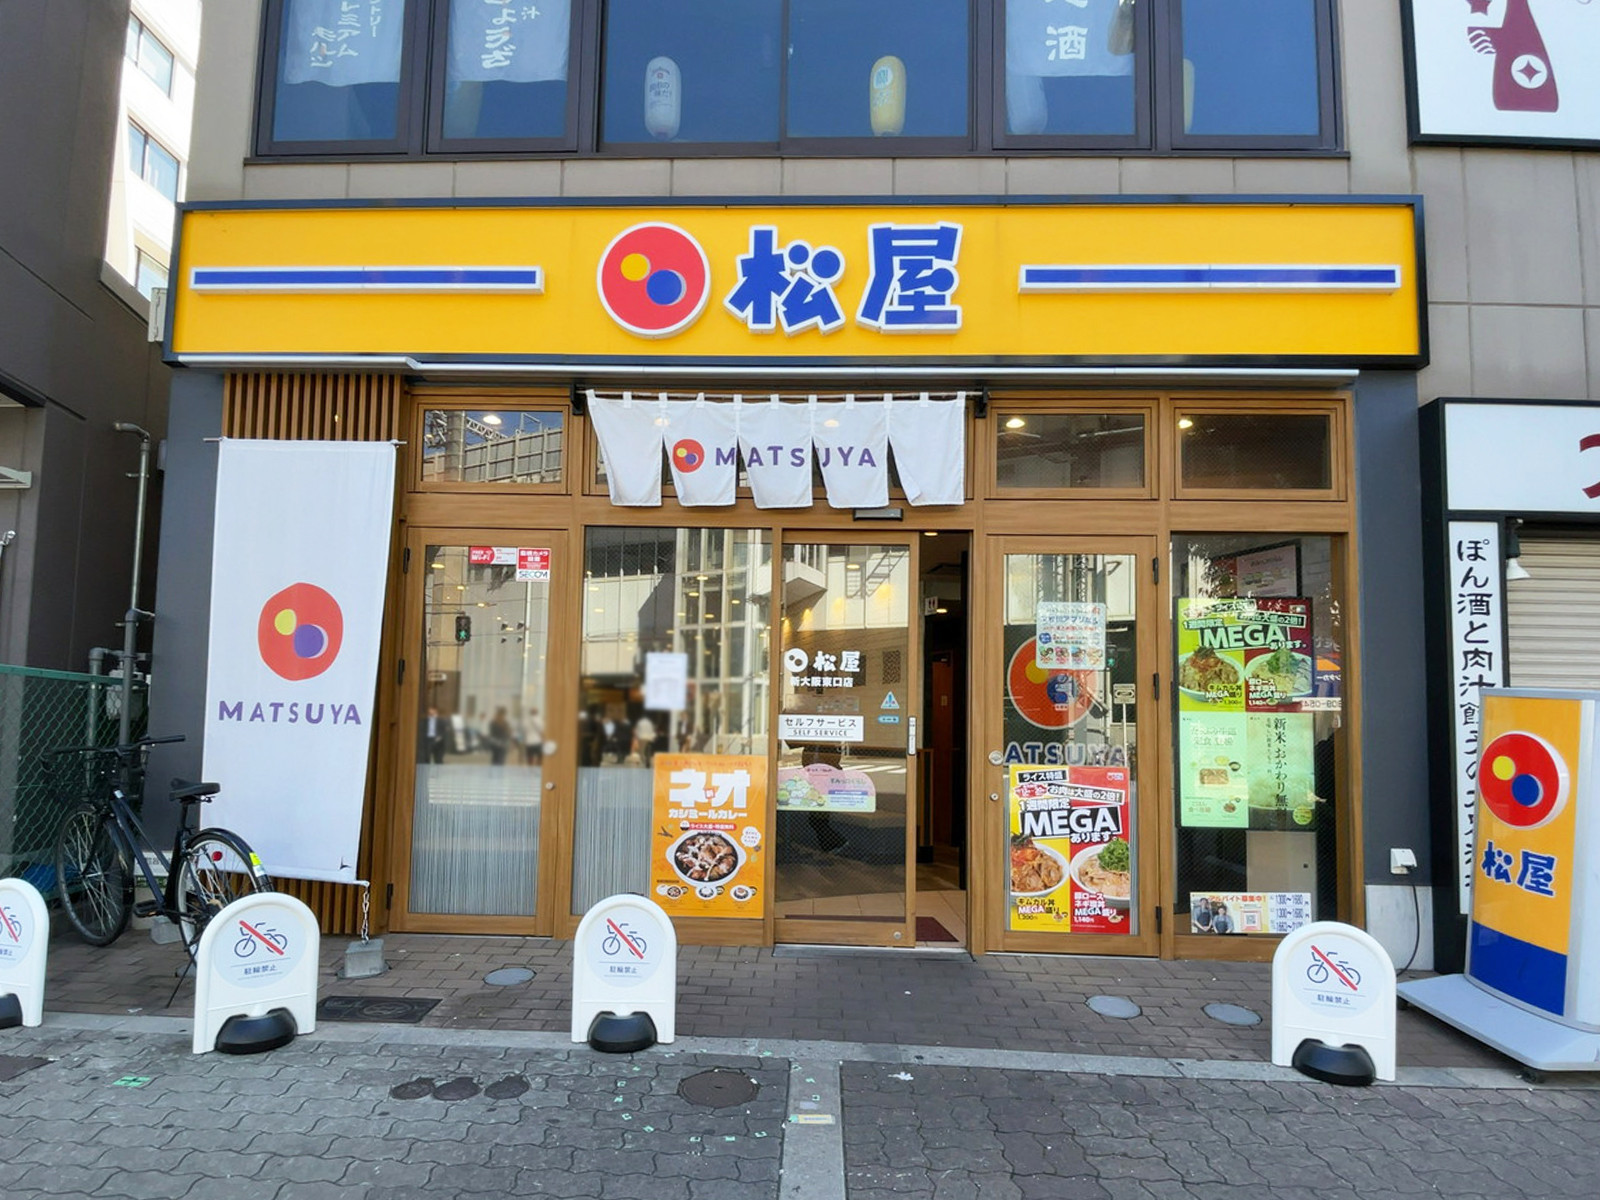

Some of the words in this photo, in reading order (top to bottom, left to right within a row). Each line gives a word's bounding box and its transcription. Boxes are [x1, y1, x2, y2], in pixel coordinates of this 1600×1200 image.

[310, 27, 336, 67] モルツ
[723, 222, 963, 336] 松屋
[716, 446, 877, 468] MATSUYA
[518, 570, 548, 578] SECOM
[1203, 624, 1286, 649] MEGA
[813, 650, 861, 672] 松屋
[790, 677, 854, 688] 新大阪東口店
[219, 700, 361, 725] MATSUYA
[785, 717, 857, 727] セルフサービス
[1023, 770, 1063, 782] ライス特盛
[669, 769, 751, 809] ネオ
[1048, 784, 1120, 801] お肉は大盛の2倍!
[1020, 798, 1070, 810] 1週間限定
[668, 809, 748, 819] カシミールカレー
[1024, 808, 1118, 836] MEGA
[1071, 831, 1118, 843] あります。
[1481, 841, 1556, 898] 松屋
[244, 964, 278, 976] 駐輪禁止
[609, 965, 638, 975] 駐輪禁止
[1317, 994, 1351, 1006] 駐輪禁止
